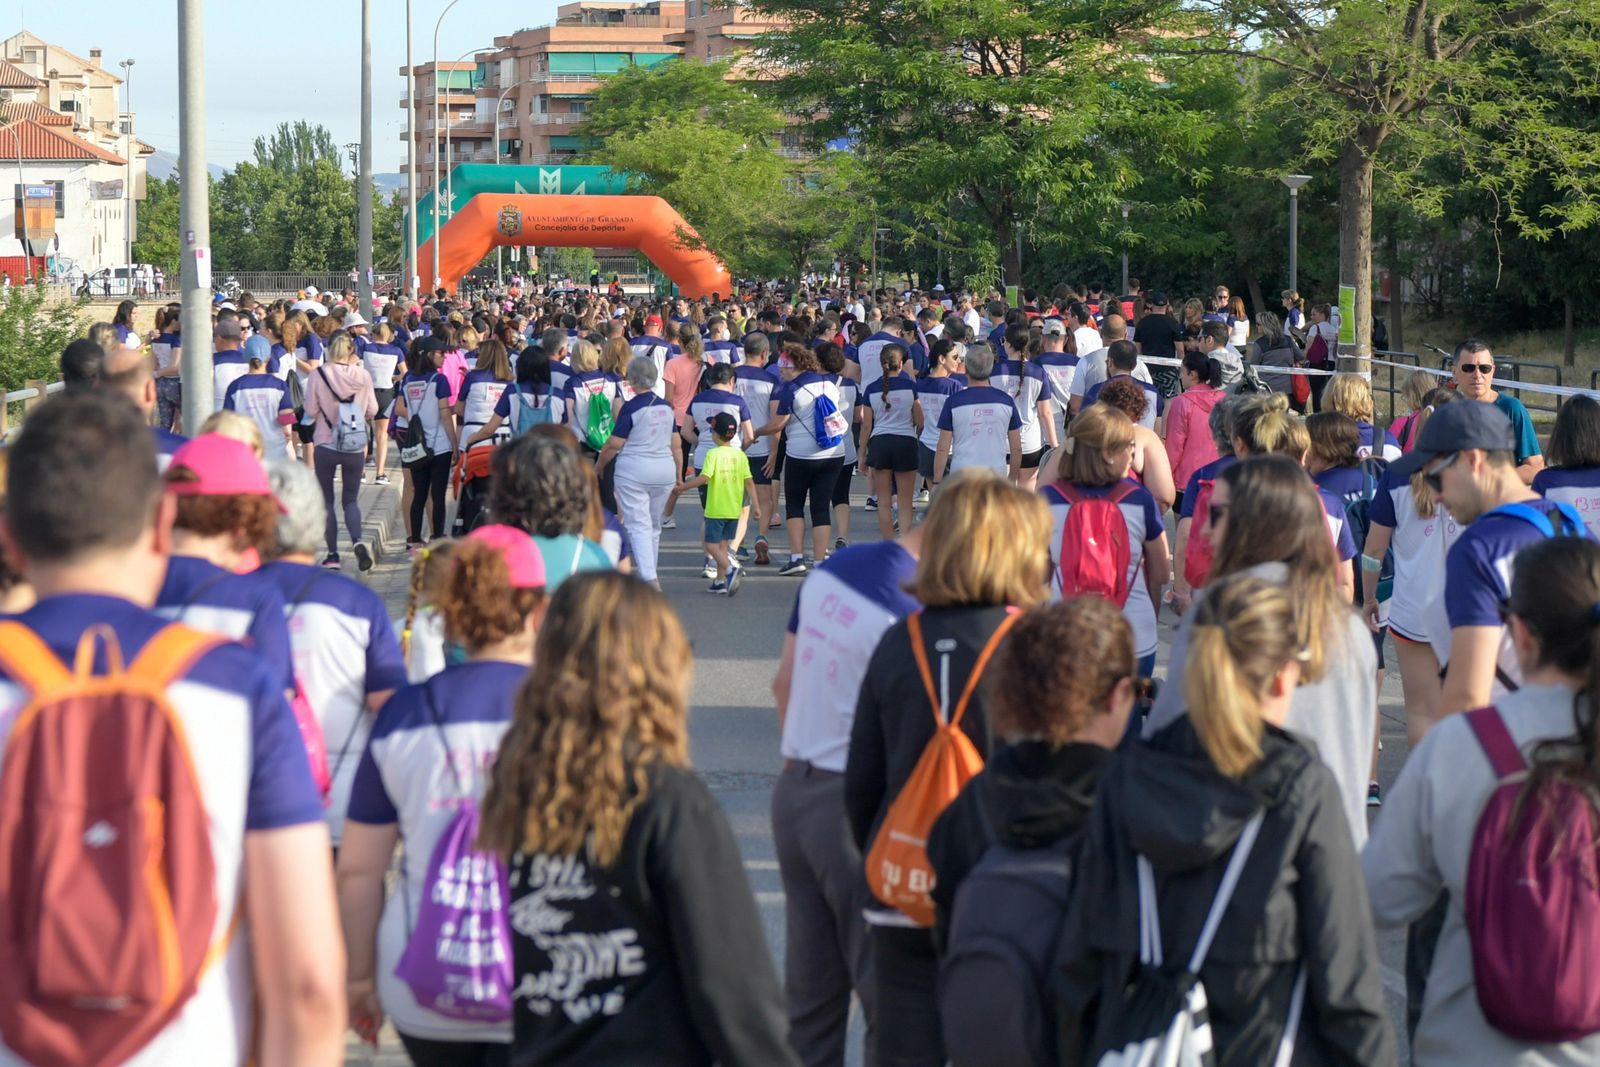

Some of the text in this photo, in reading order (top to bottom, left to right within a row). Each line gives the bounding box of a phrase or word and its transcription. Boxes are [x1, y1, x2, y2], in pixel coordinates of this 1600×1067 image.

[597, 215, 635, 224] GRANADA
[579, 224, 589, 232] de
[591, 224, 625, 233] Deportes
